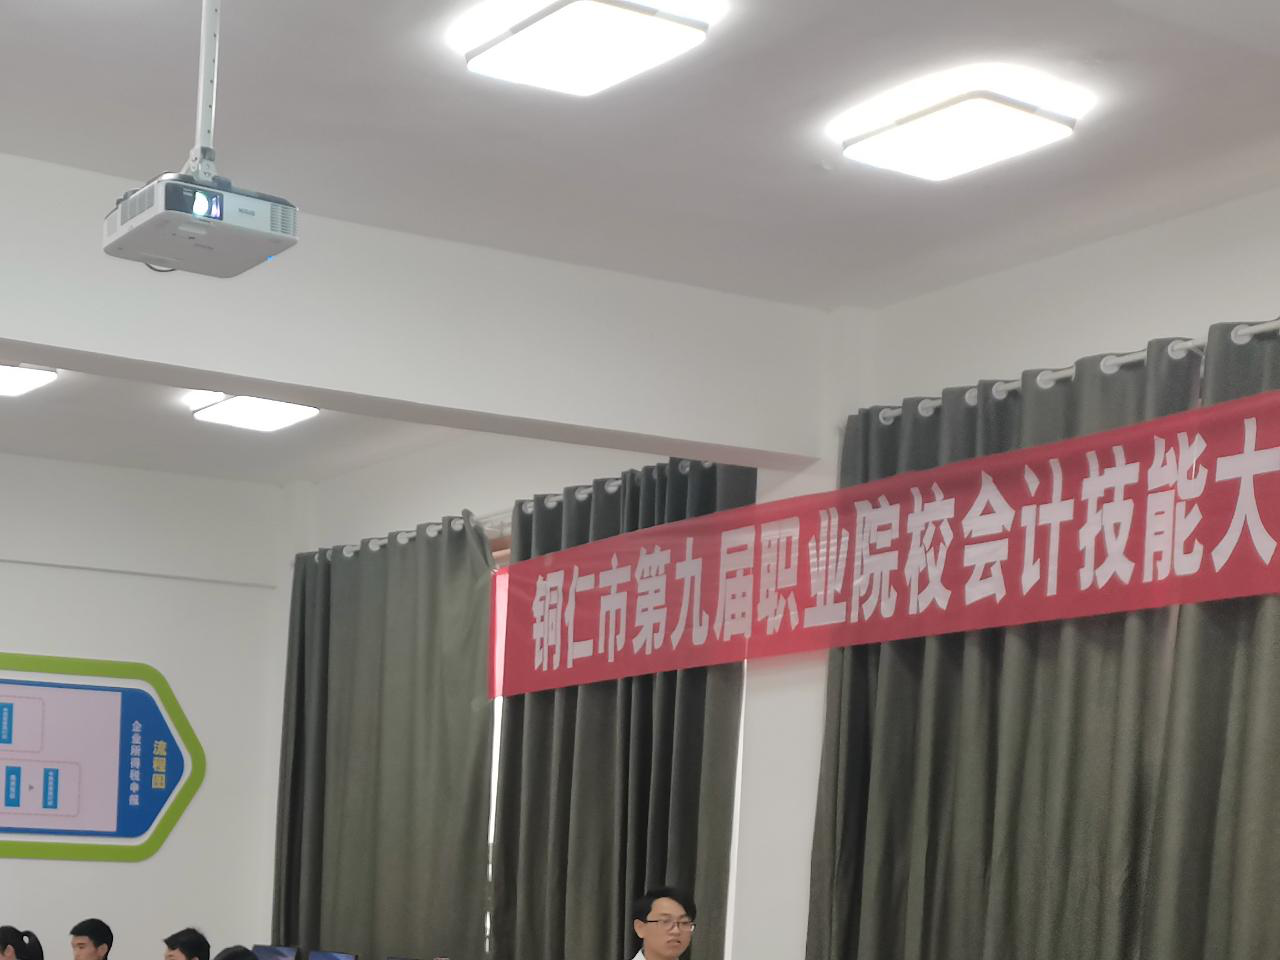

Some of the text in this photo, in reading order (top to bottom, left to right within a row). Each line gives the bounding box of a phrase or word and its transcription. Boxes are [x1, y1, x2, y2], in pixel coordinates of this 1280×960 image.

[532, 416, 1280, 672] 铜仁市第九届职业院校会计技能大
[151, 740, 168, 789] 流程图
